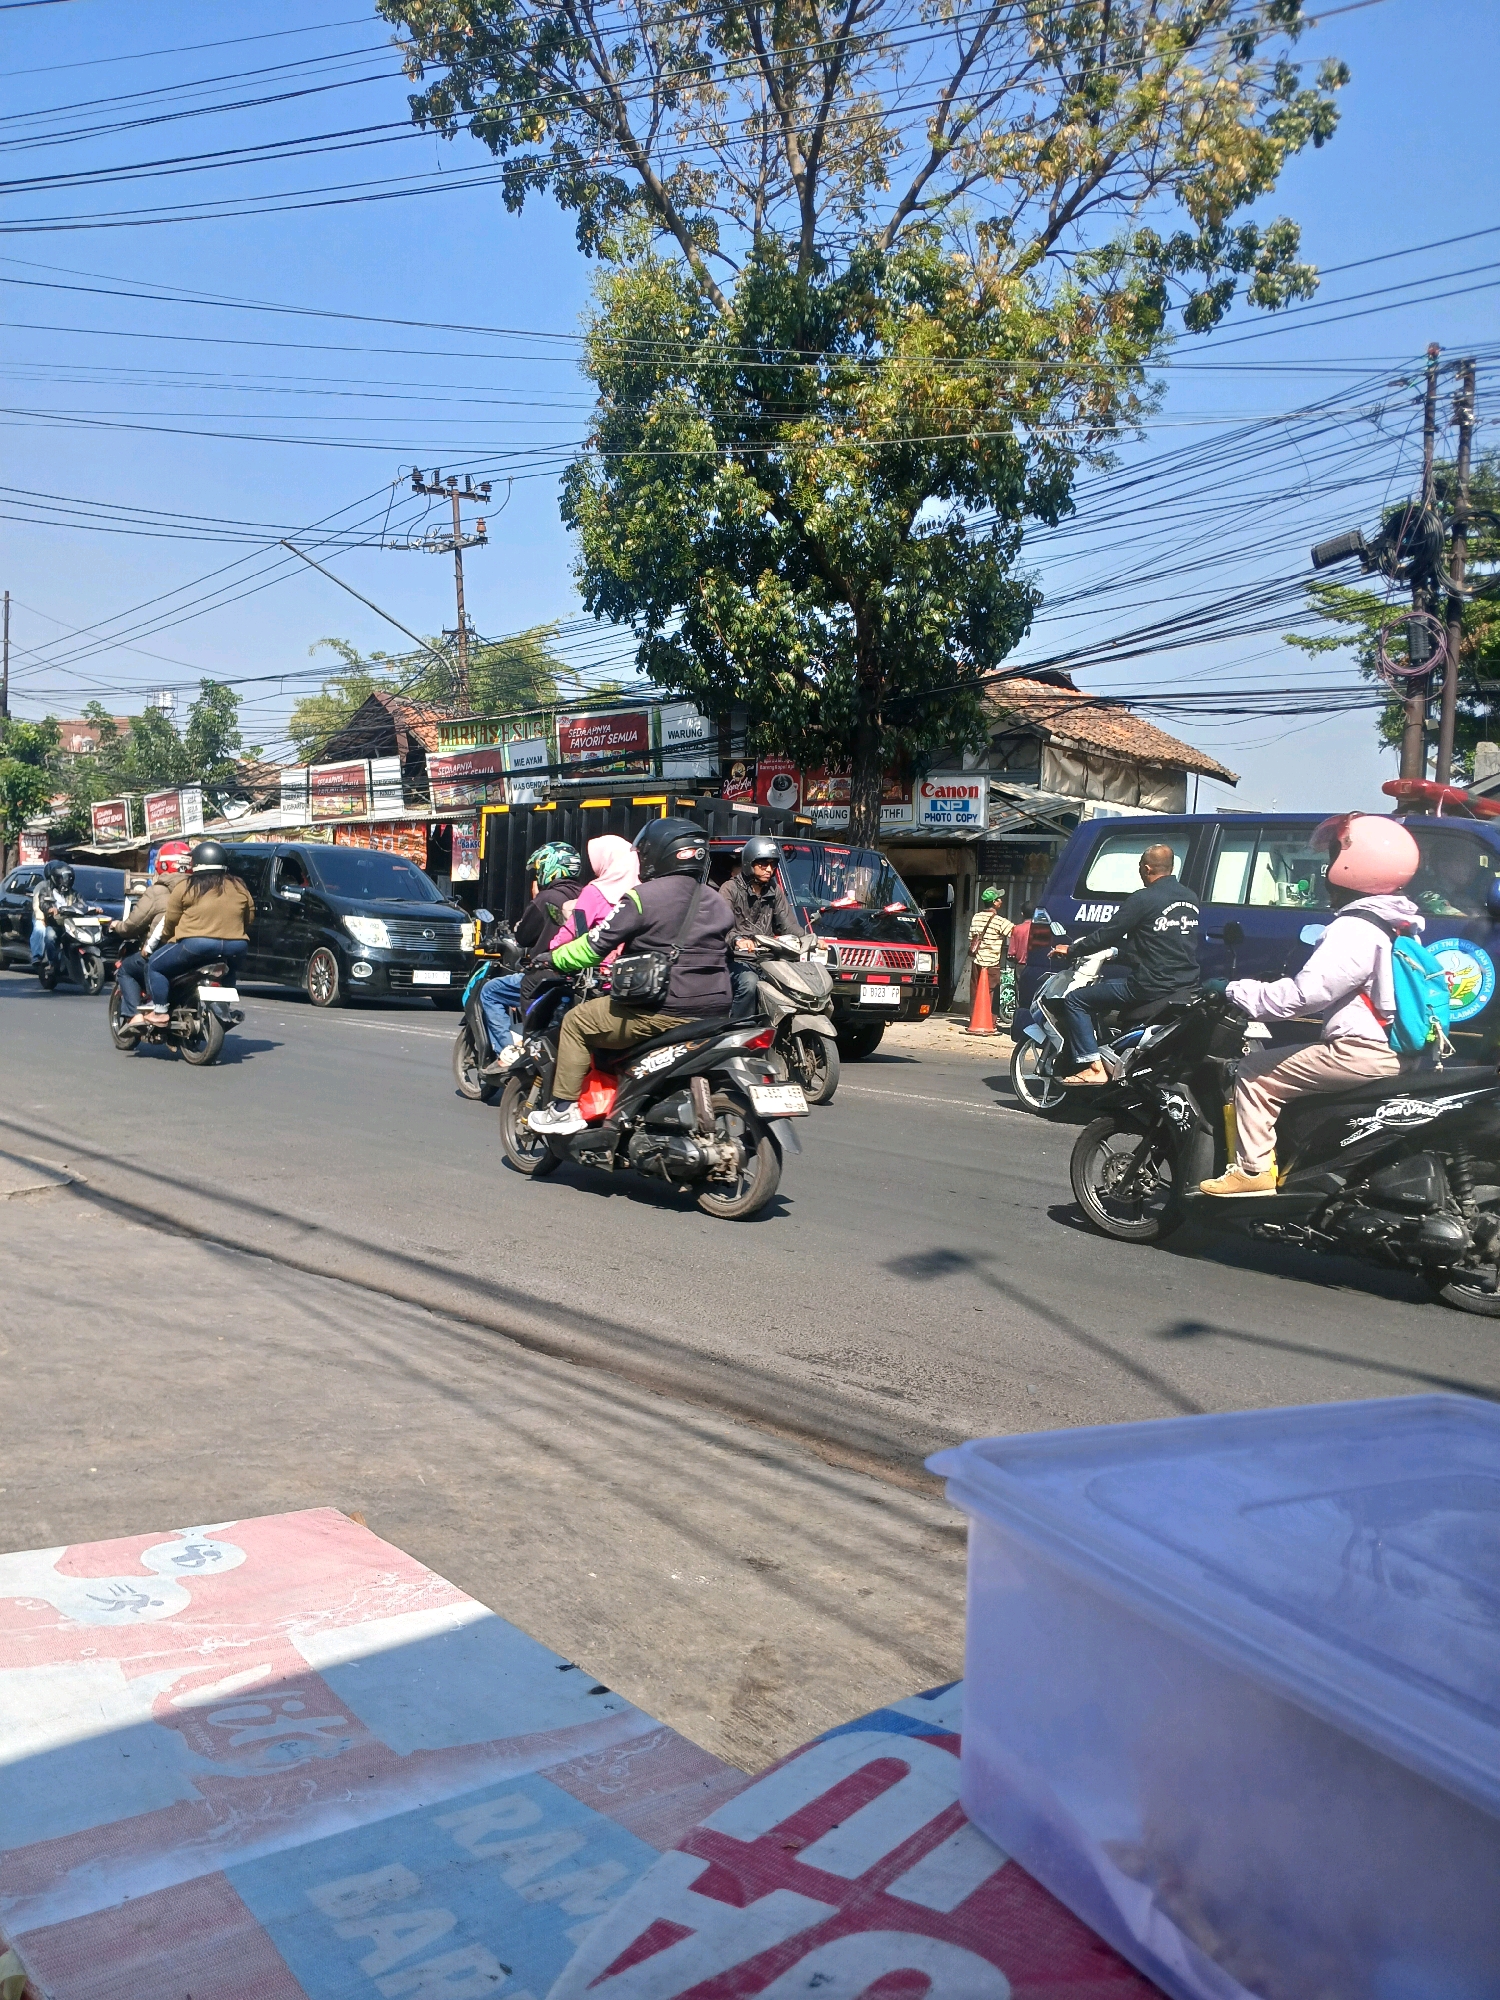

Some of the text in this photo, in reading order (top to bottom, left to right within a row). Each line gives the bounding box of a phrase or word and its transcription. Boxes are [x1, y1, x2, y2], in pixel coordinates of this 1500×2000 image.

[570, 730, 638, 749] FAVORIT SEMUA
[668, 728, 703, 740] WARUNG
[526, 755, 543, 766] AYAM
[921, 782, 980, 799] Canon
[936, 801, 963, 811] NP
[811, 808, 903, 819] WARUNG UTHFI
[924, 812, 978, 823] PHOTO COPY
[1074, 903, 1120, 923] AMB
[1449, 1003, 1481, 1020] LAIMAN
